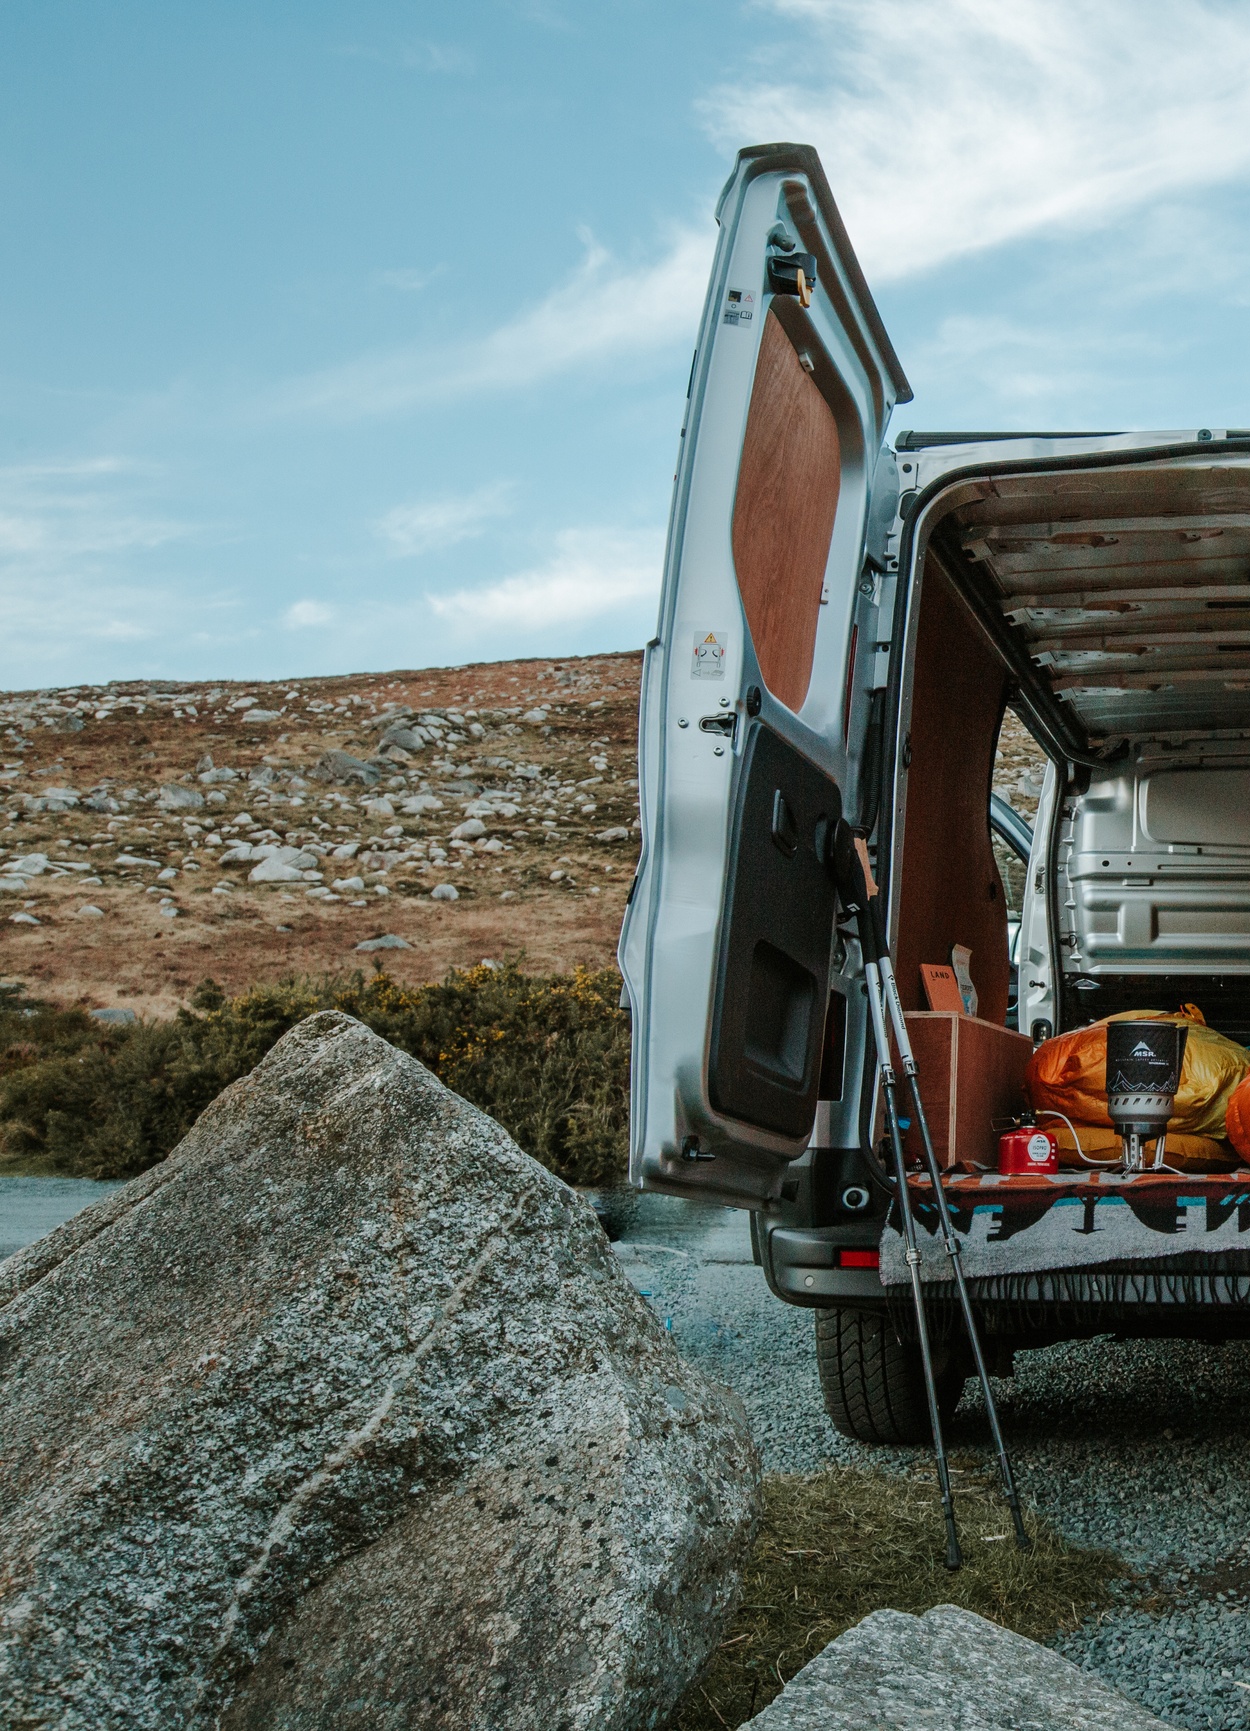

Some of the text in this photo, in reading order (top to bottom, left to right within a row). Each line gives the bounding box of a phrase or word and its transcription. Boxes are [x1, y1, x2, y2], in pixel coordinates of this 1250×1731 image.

[930, 971, 950, 979] LAND
[891, 982, 906, 1030] Black Diamond
